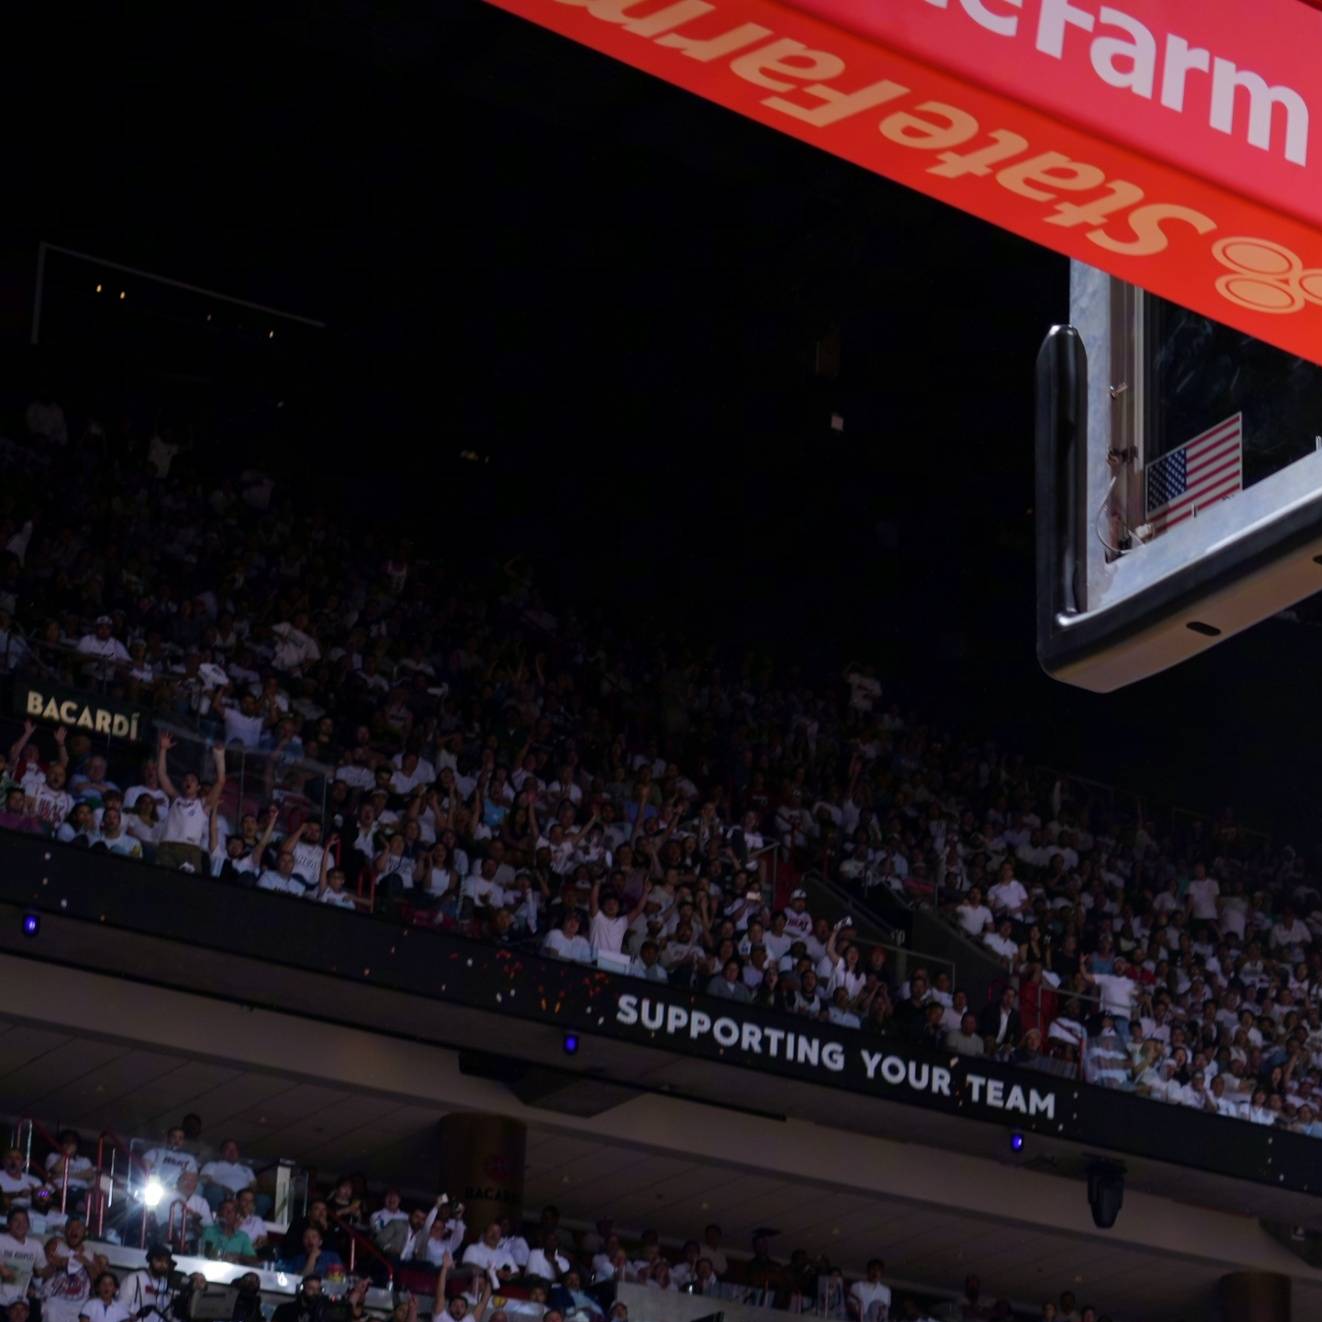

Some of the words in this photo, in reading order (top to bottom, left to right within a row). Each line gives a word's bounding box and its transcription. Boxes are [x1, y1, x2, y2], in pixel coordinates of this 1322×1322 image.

[924, 0, 1308, 166] eFarm
[27, 690, 140, 742] BACARDÍ
[616, 993, 846, 1072] SUPPORTING
[860, 1048, 951, 1097] YOUR
[966, 1073, 1056, 1120] TEAM
